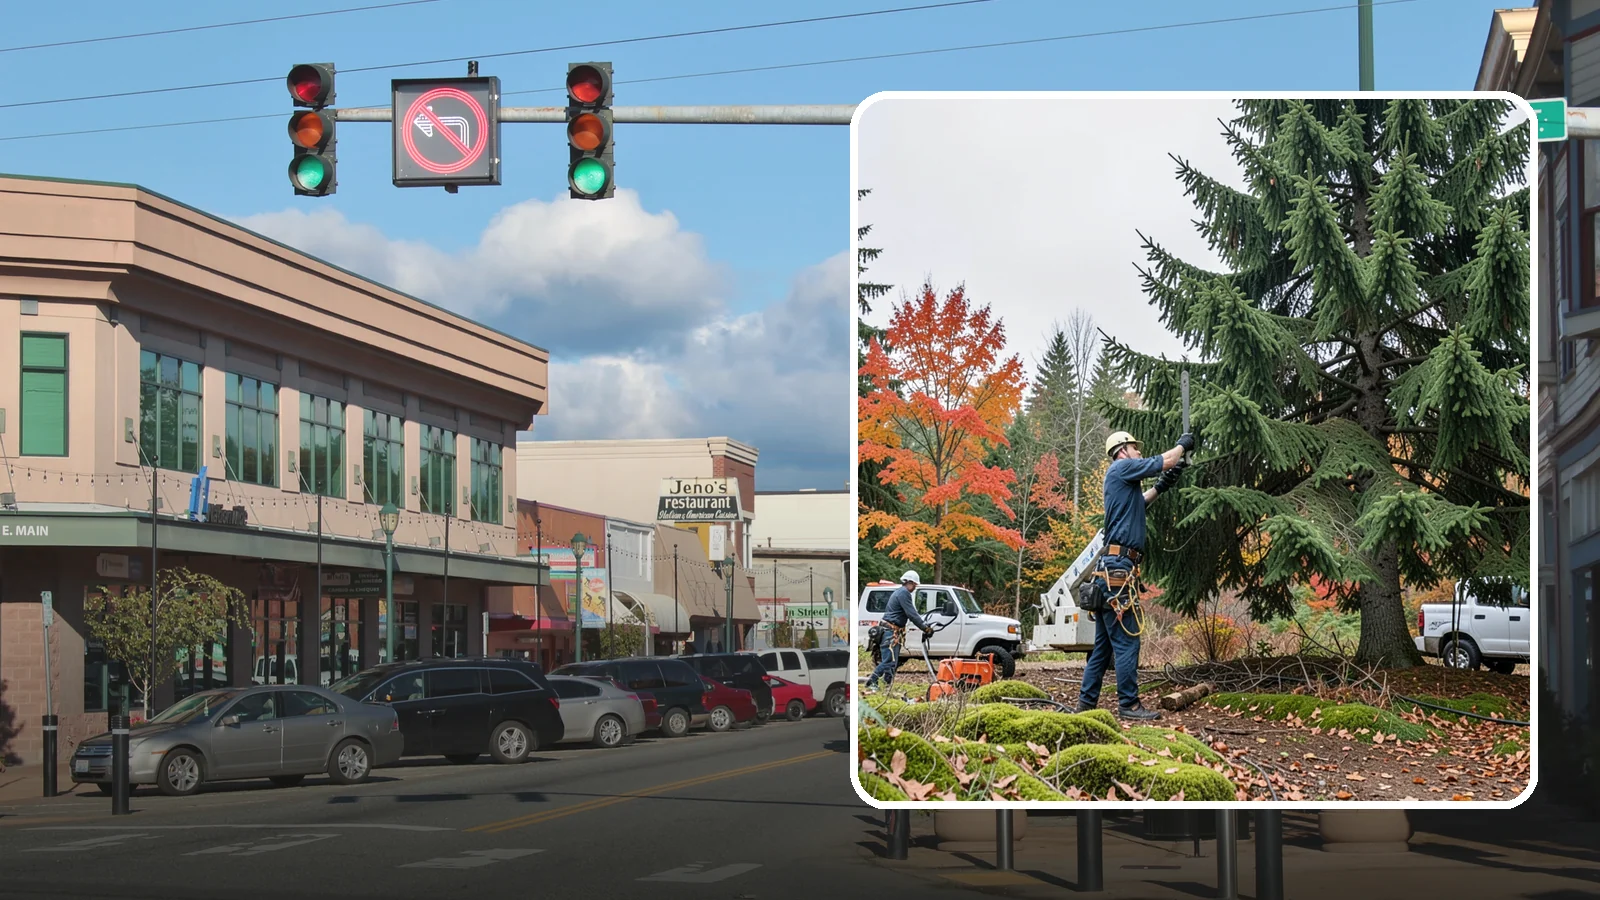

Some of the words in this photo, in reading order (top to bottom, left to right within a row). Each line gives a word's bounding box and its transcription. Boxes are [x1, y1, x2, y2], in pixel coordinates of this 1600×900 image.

[670, 480, 727, 494] Jeno's
[665, 497, 731, 509] restaurant
[659, 510, 681, 519] Italian
[686, 510, 714, 519] American
[715, 510, 737, 519] Cuisine
[2, 525, 13, 536] E.
[15, 525, 49, 536] MAIN
[797, 607, 828, 617] Street
